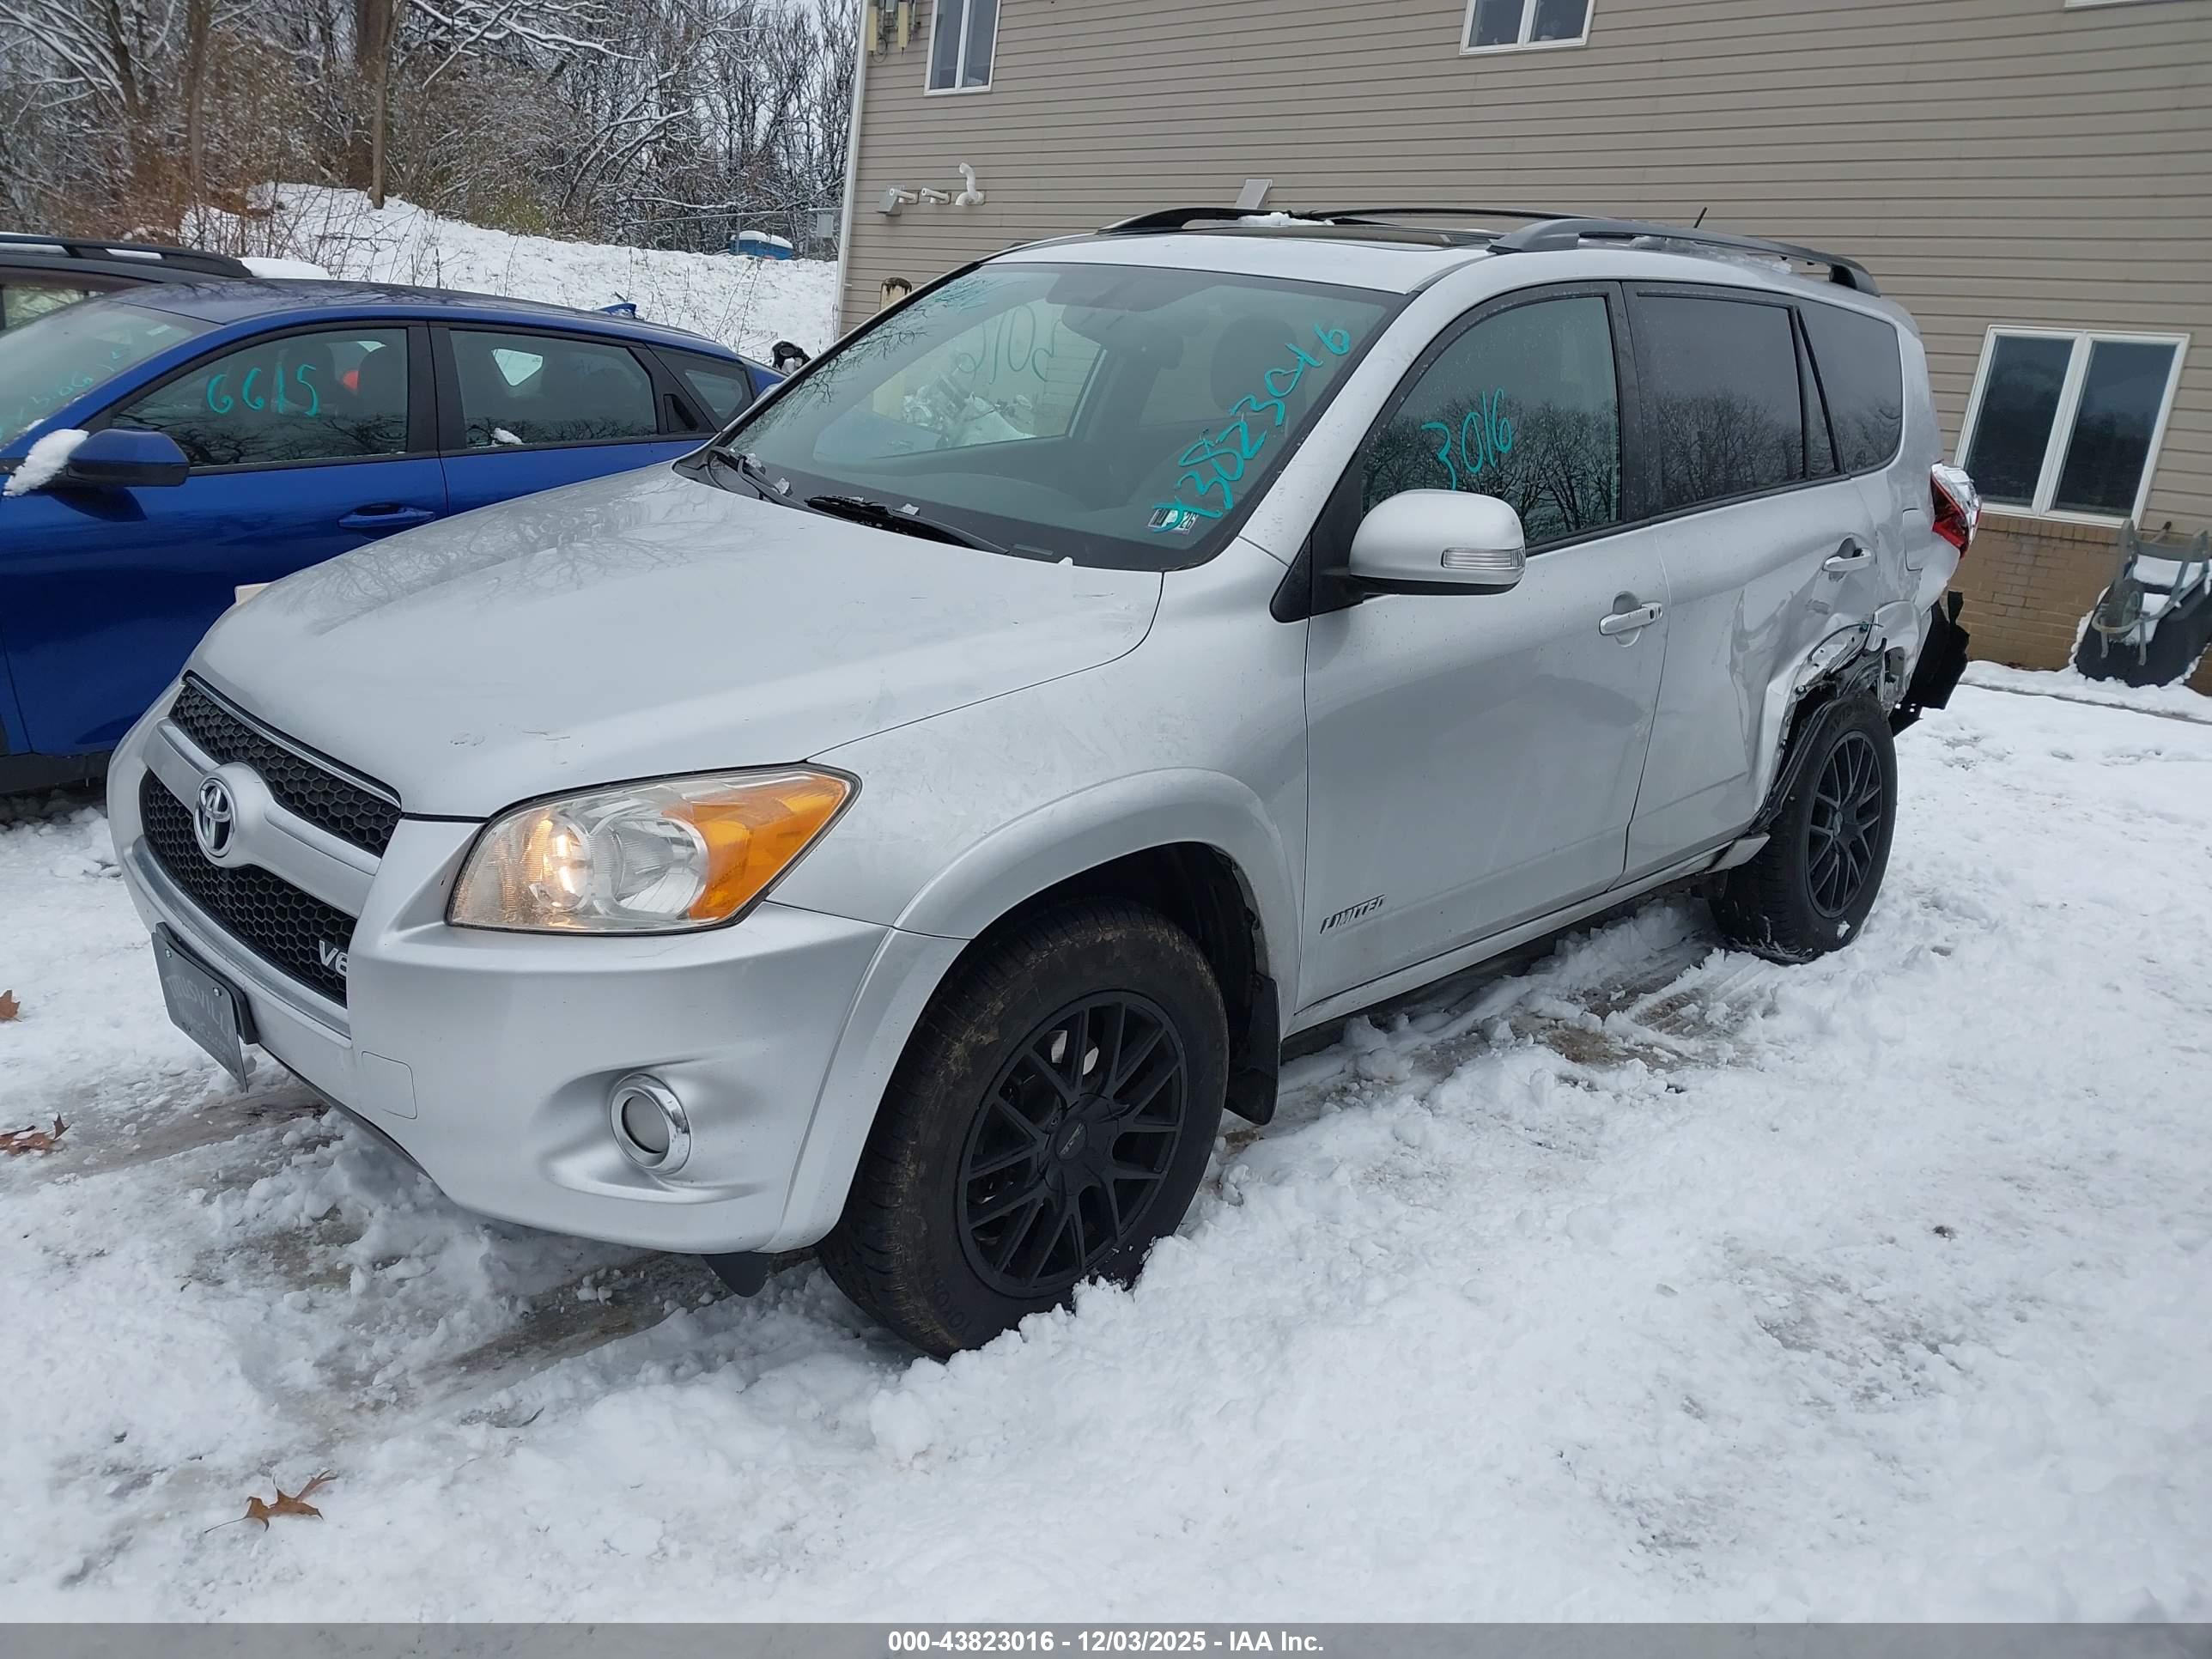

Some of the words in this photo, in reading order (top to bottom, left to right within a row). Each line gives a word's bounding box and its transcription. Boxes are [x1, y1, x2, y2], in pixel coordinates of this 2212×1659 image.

[205, 361, 319, 417] 6615
[1420, 387, 1512, 490] 3016
[1319, 894, 1386, 935] LIMITED
[319, 939, 348, 977] V6
